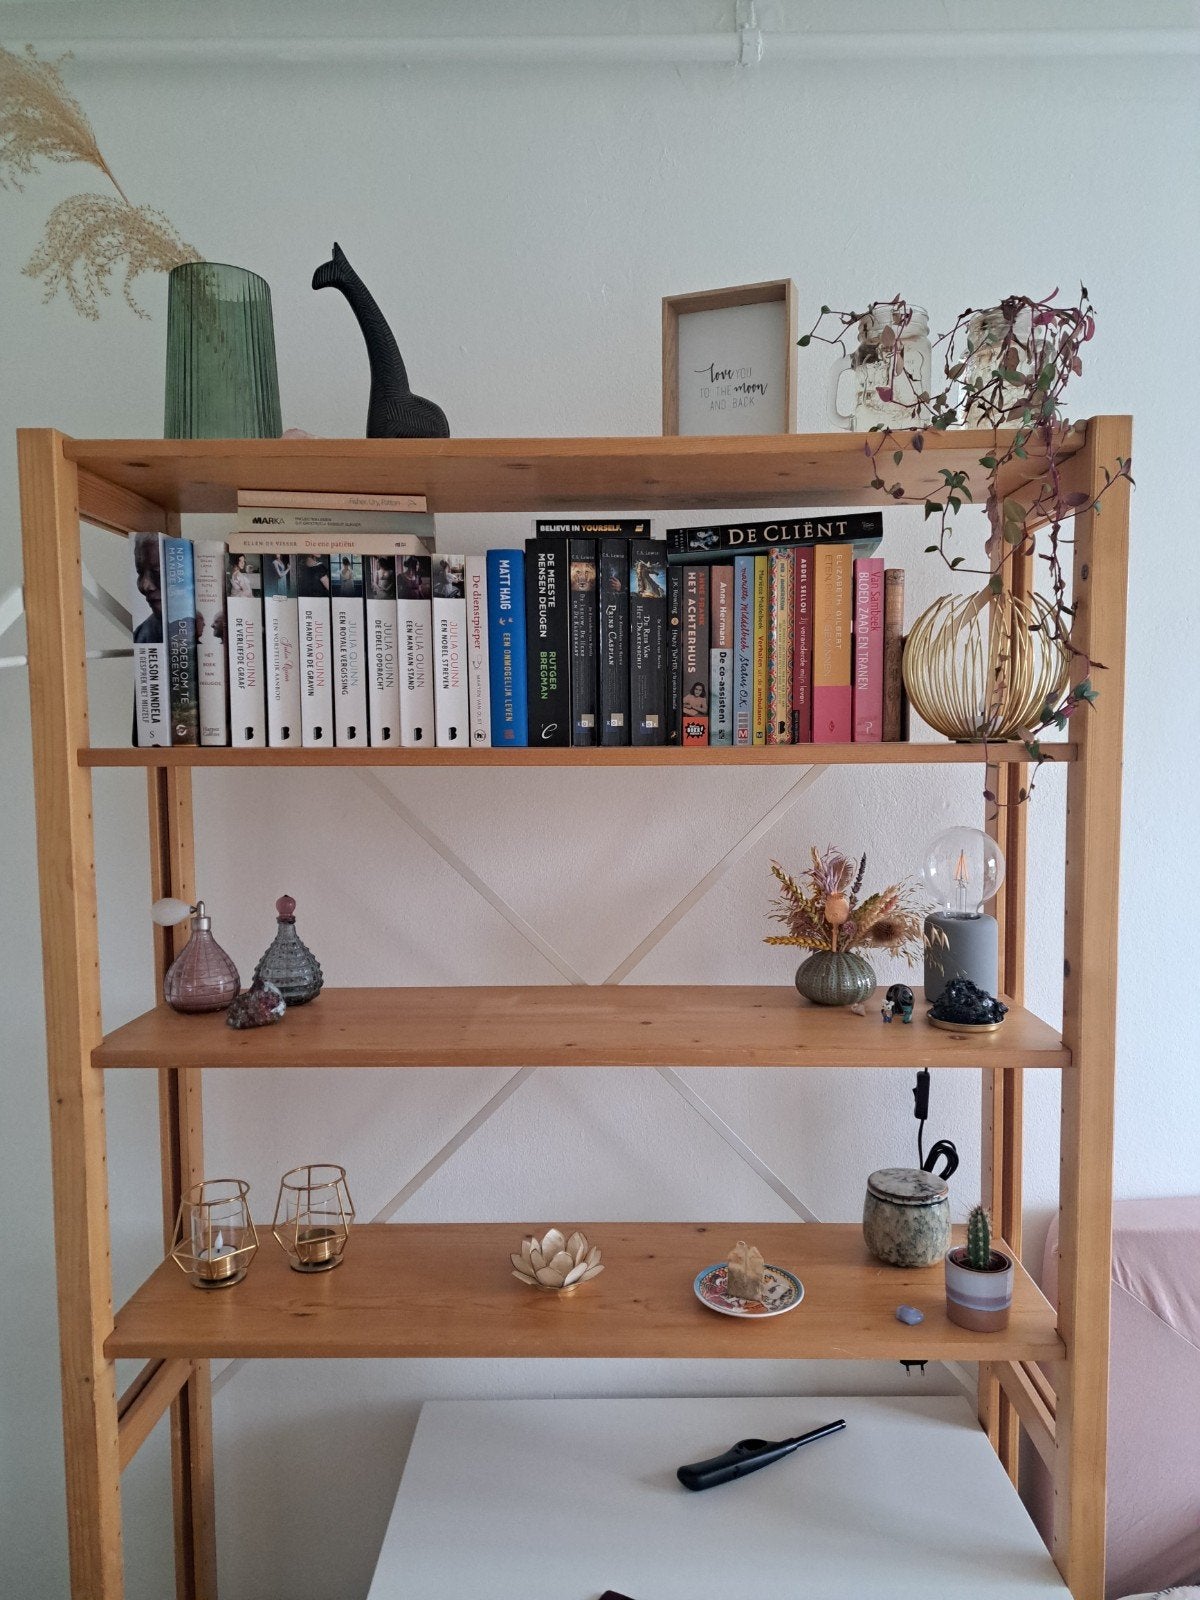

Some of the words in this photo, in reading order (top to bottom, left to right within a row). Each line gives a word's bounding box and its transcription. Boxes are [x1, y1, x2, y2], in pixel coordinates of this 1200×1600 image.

[694, 363, 734, 383] love
[735, 368, 752, 378] YOU
[700, 388, 710, 398] TO
[716, 385, 732, 396] THE
[734, 382, 768, 395] moon
[710, 400, 727, 411] AND
[733, 397, 755, 408] BACK
[252, 517, 285, 525] MARKA
[728, 529, 757, 545] DE
[763, 521, 848, 541] CLIËNT
[330, 540, 355, 549] patiënt
[176, 547, 185, 583] NDABA
[499, 559, 511, 585] MATT
[547, 553, 555, 567] DE
[472, 575, 481, 588] De
[537, 553, 547, 596] MENSEN
[547, 569, 556, 608] MEESTE
[688, 572, 696, 594] HET
[835, 554, 843, 606] ELIZABETH
[871, 571, 881, 588] Van
[499, 587, 512, 610] HAIG
[719, 582, 727, 604] Anne
[857, 573, 869, 605] BLOED,
[236, 618, 243, 626] DE
[305, 610, 312, 619] DE
[374, 620, 382, 628] DE
[440, 619, 448, 632] EEN
[471, 591, 482, 649] dienstpieper
[538, 597, 548, 638] DEUGEN
[858, 607, 869, 634] ZAAD
[870, 591, 881, 632] Sambeek
[178, 621, 188, 635] DE
[245, 621, 254, 649] JULIA
[305, 621, 313, 642] HAND
[315, 621, 323, 649] JULIA
[339, 627, 347, 653] ROYALE
[348, 621, 357, 649] JULIA
[384, 623, 392, 651] JULIA
[415, 623, 423, 651] JULIA
[450, 621, 459, 652] JULIA
[503, 633, 511, 647] EEN
[688, 599, 696, 673] ACHTERHUIS
[719, 607, 727, 646] Hermans
[179, 638, 188, 669] MOED
[236, 628, 244, 664] VERLIEFDE
[306, 643, 314, 658] VAN
[406, 635, 414, 651] MAN
[757, 635, 765, 667] Verhalen
[800, 626, 808, 666] veranderde
[858, 635, 869, 650] EN
[139, 656, 147, 684] GESPREK
[148, 648, 159, 681] NELSON
[170, 634, 180, 691] VERGEVEN
[246, 652, 256, 687] QUINN
[307, 660, 313, 668] DE
[315, 652, 325, 687] QUINN
[349, 652, 358, 687] QUINN
[375, 653, 384, 690] OPDRACHT
[384, 653, 394, 688] QUINN
[415, 653, 425, 688] QUINN
[451, 654, 460, 688] QUINN
[548, 651, 557, 690] RUTGER
[719, 651, 727, 664] De
[739, 653, 749, 687] Status
[857, 652, 869, 690] TRANEN
[180, 672, 189, 688] OM
[237, 666, 245, 689] GRAAF
[340, 655, 348, 695] VERGISSING
[407, 668, 415, 691] STAND
[441, 658, 450, 690] STREVEN
[503, 649, 513, 698] ONMOGELIJK
[540, 651, 549, 700] BREGMAN
[149, 684, 161, 724] MANDELA
[180, 692, 190, 704] TE
[718, 666, 726, 724] co-assistent
[738, 690, 748, 708] O.K.
[800, 685, 808, 704] leven
[141, 699, 149, 724] MIJZELF
[505, 699, 514, 722] LEVEN
